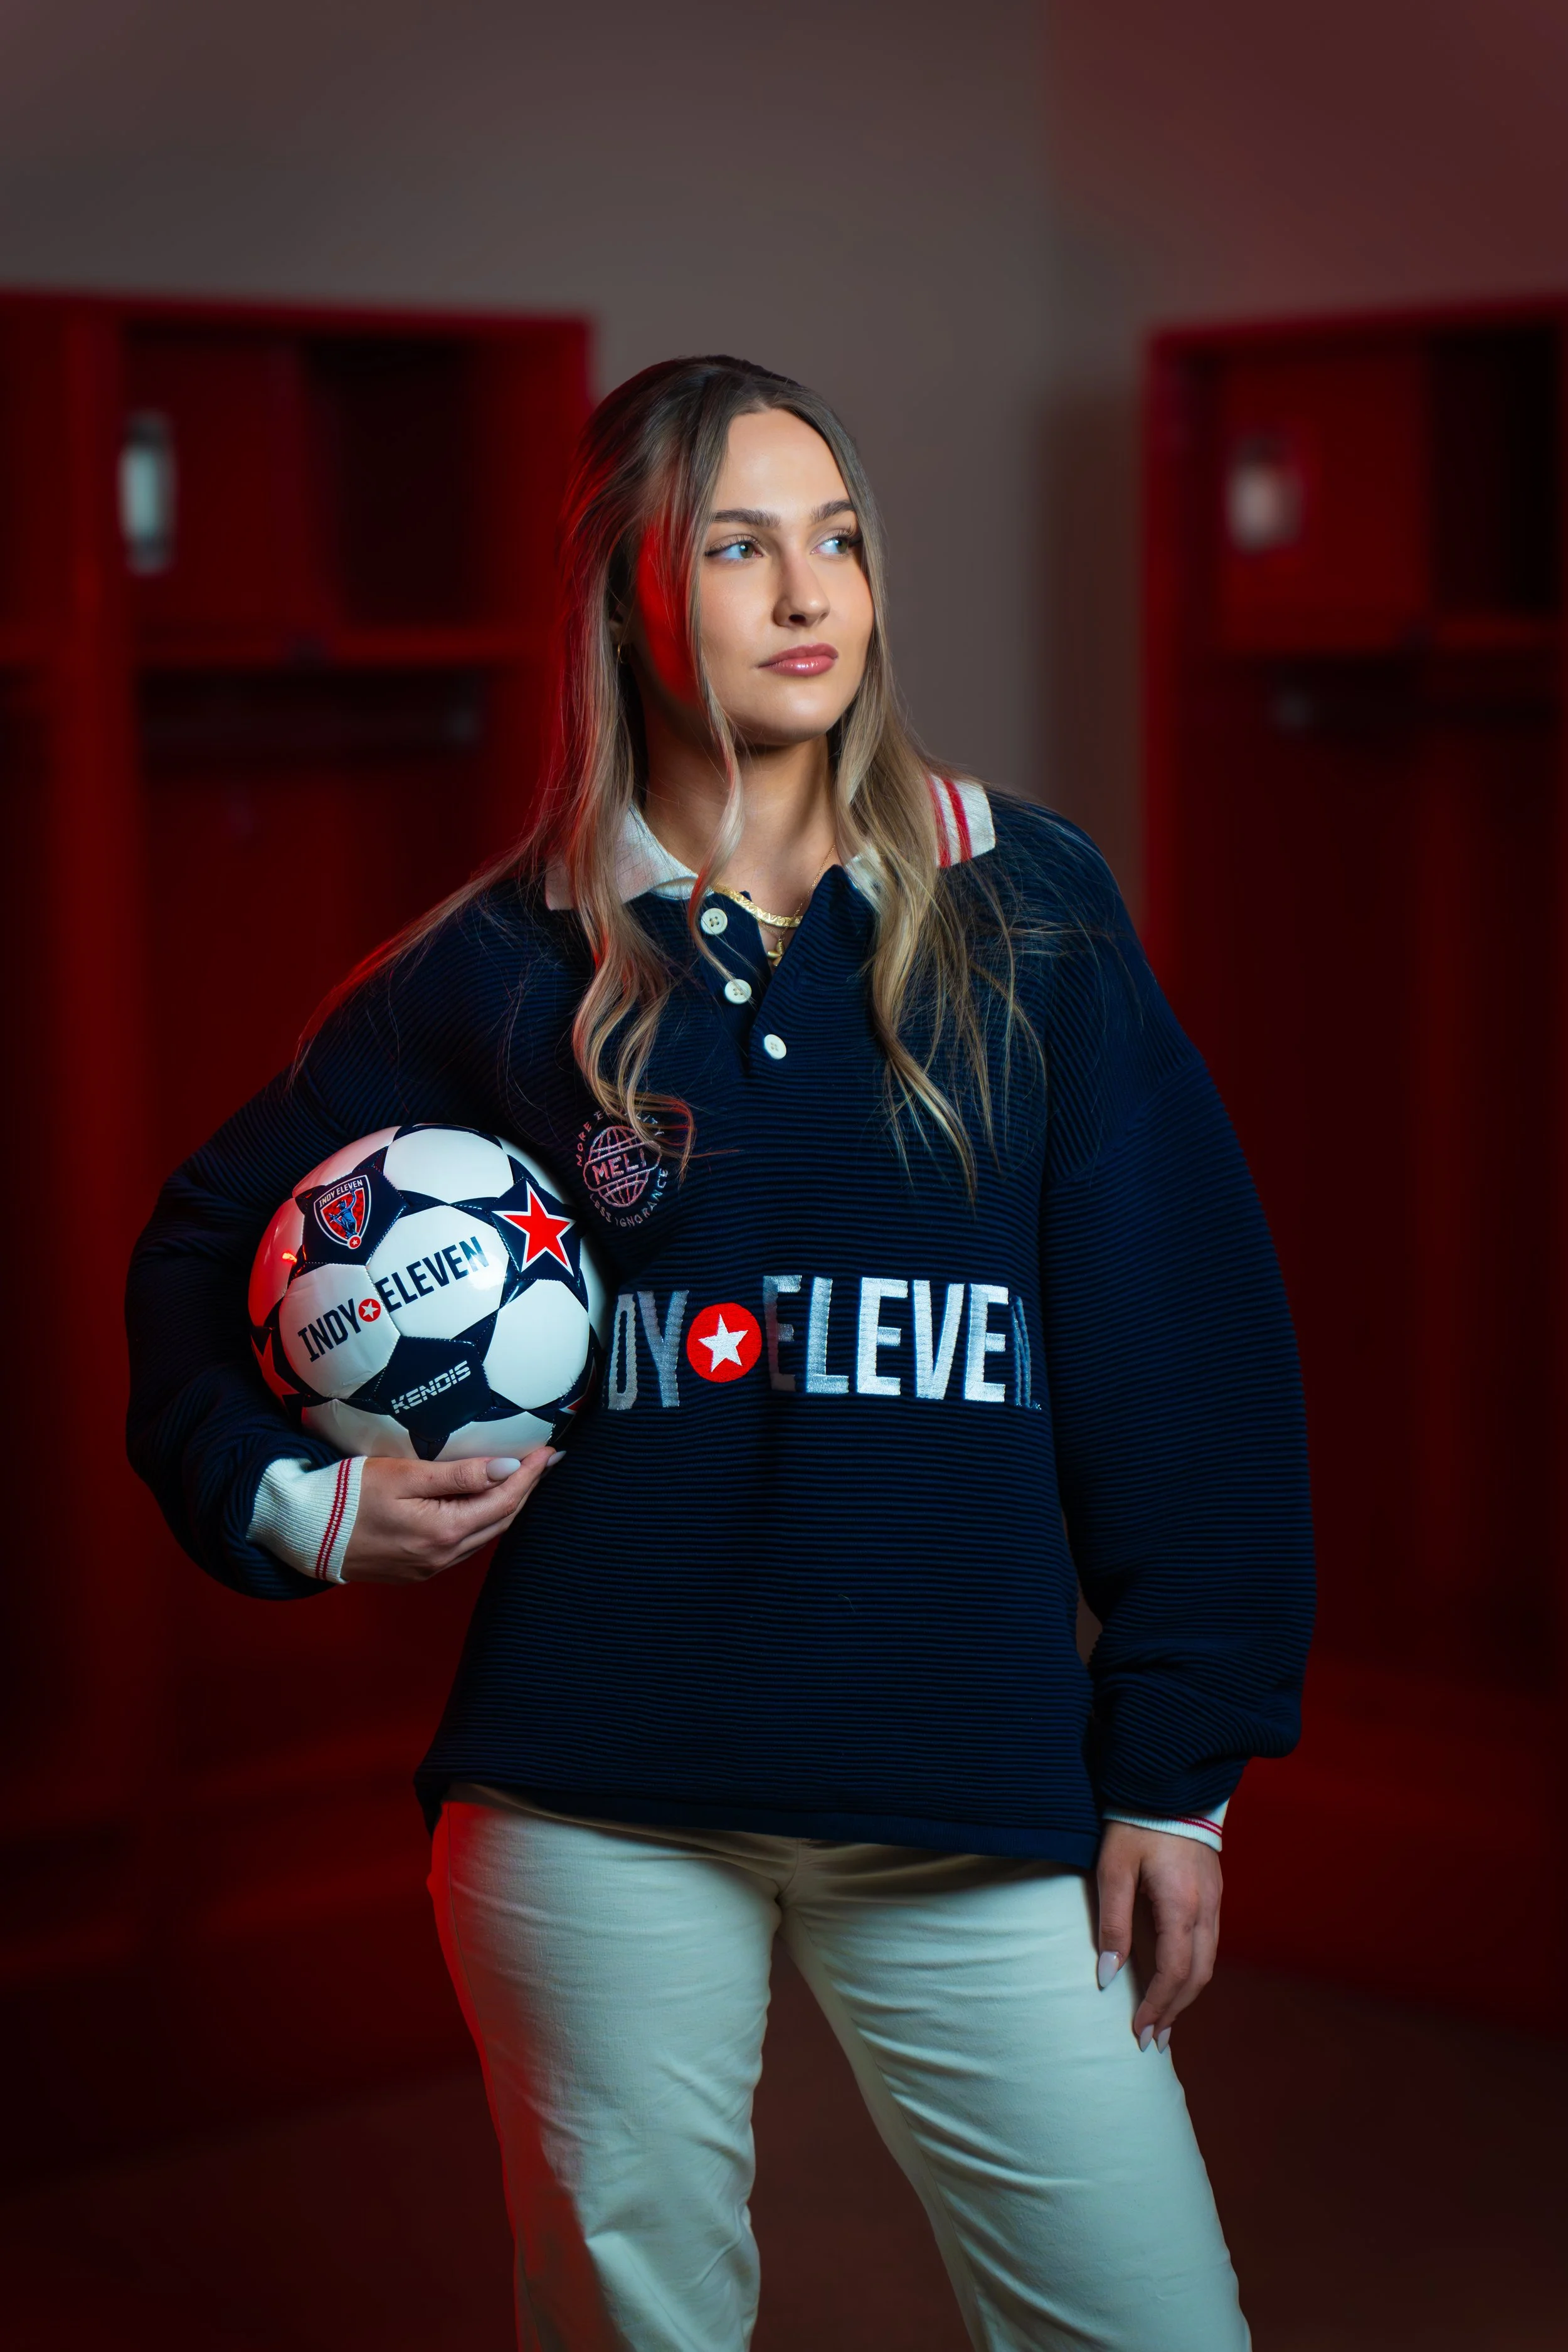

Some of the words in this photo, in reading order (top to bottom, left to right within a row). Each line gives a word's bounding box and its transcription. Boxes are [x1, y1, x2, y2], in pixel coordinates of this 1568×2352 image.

[576, 1121, 592, 1167] MORE
[319, 1190, 335, 1208] INDY
[336, 1179, 363, 1195] ELEVEN
[590, 1193, 612, 1222] LESS
[615, 1167, 669, 1228] IGNORANCE
[298, 1298, 362, 1363] INDY
[375, 1236, 490, 1313] ELEVEN
[607, 1289, 690, 1411] DY
[391, 1360, 472, 1415] KENDIS
